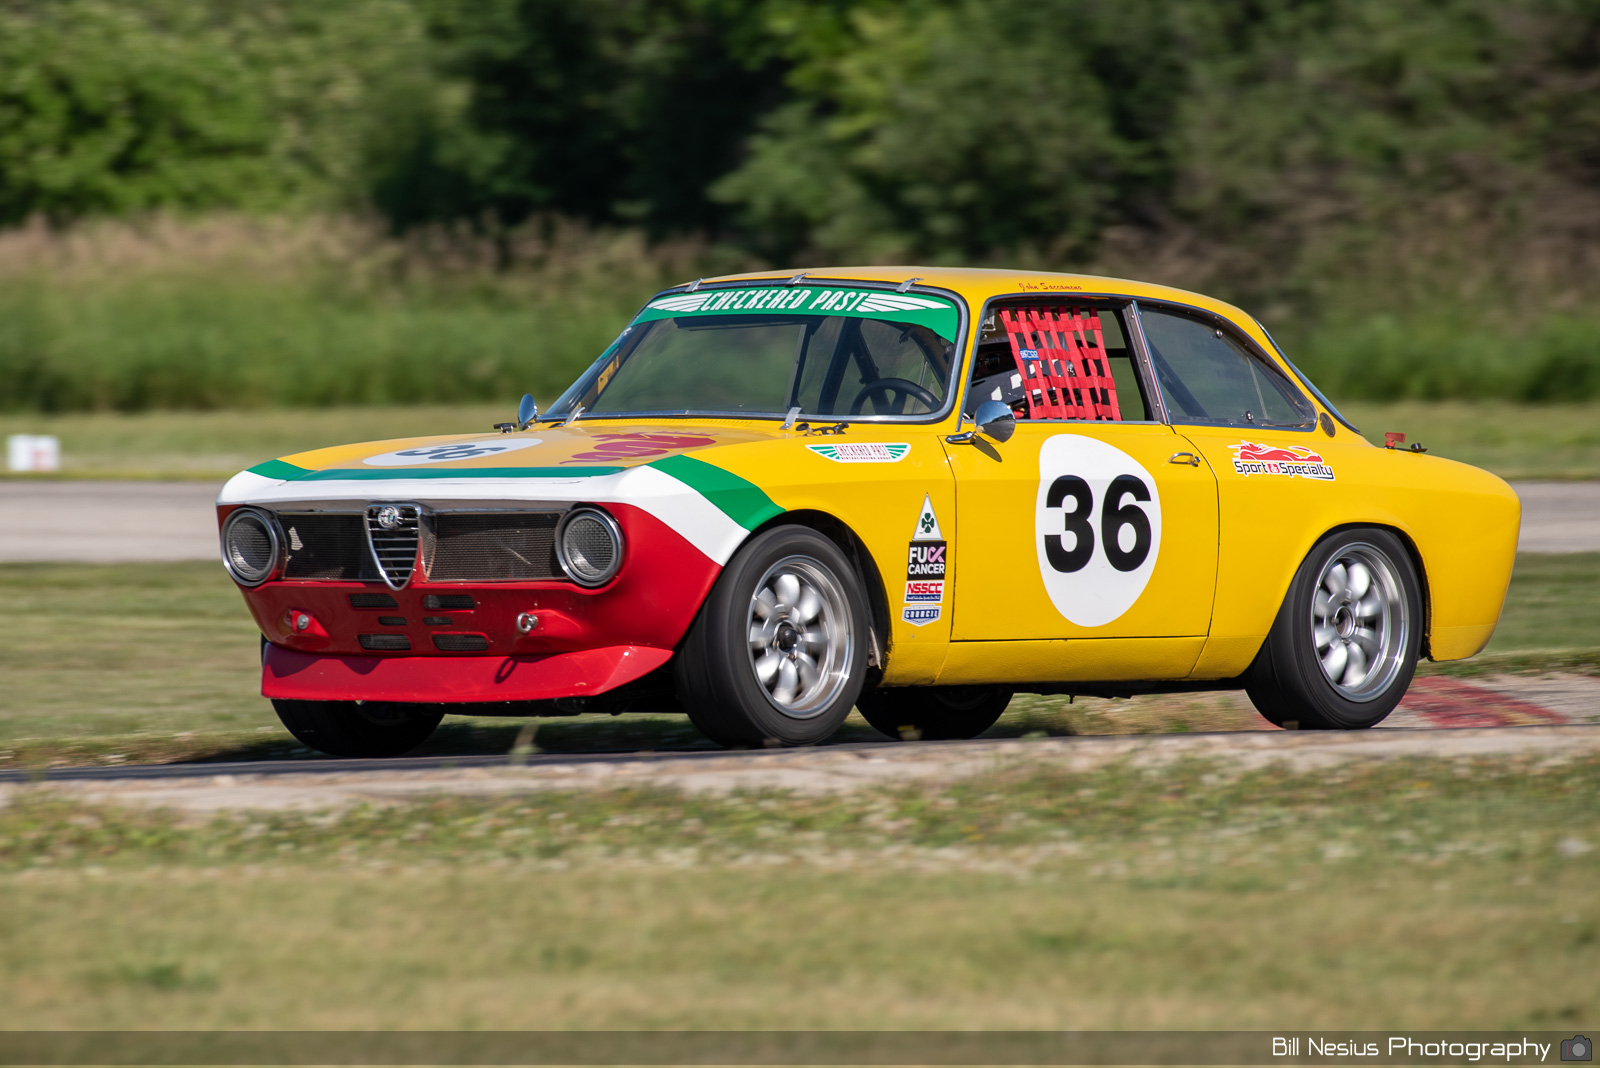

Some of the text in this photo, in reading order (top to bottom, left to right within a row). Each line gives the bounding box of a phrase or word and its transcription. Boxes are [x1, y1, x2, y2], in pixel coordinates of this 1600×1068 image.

[701, 289, 869, 312] CHECKERED PAST
[395, 444, 507, 460] 36
[1234, 461, 1268, 475] Sport
[1278, 462, 1334, 479] Specialty
[1044, 474, 1152, 573] 36
[908, 546, 946, 563] FUCK
[907, 563, 945, 575] CANCER
[907, 583, 943, 594] NSSCC
[905, 609, 938, 619] COUNCIL
